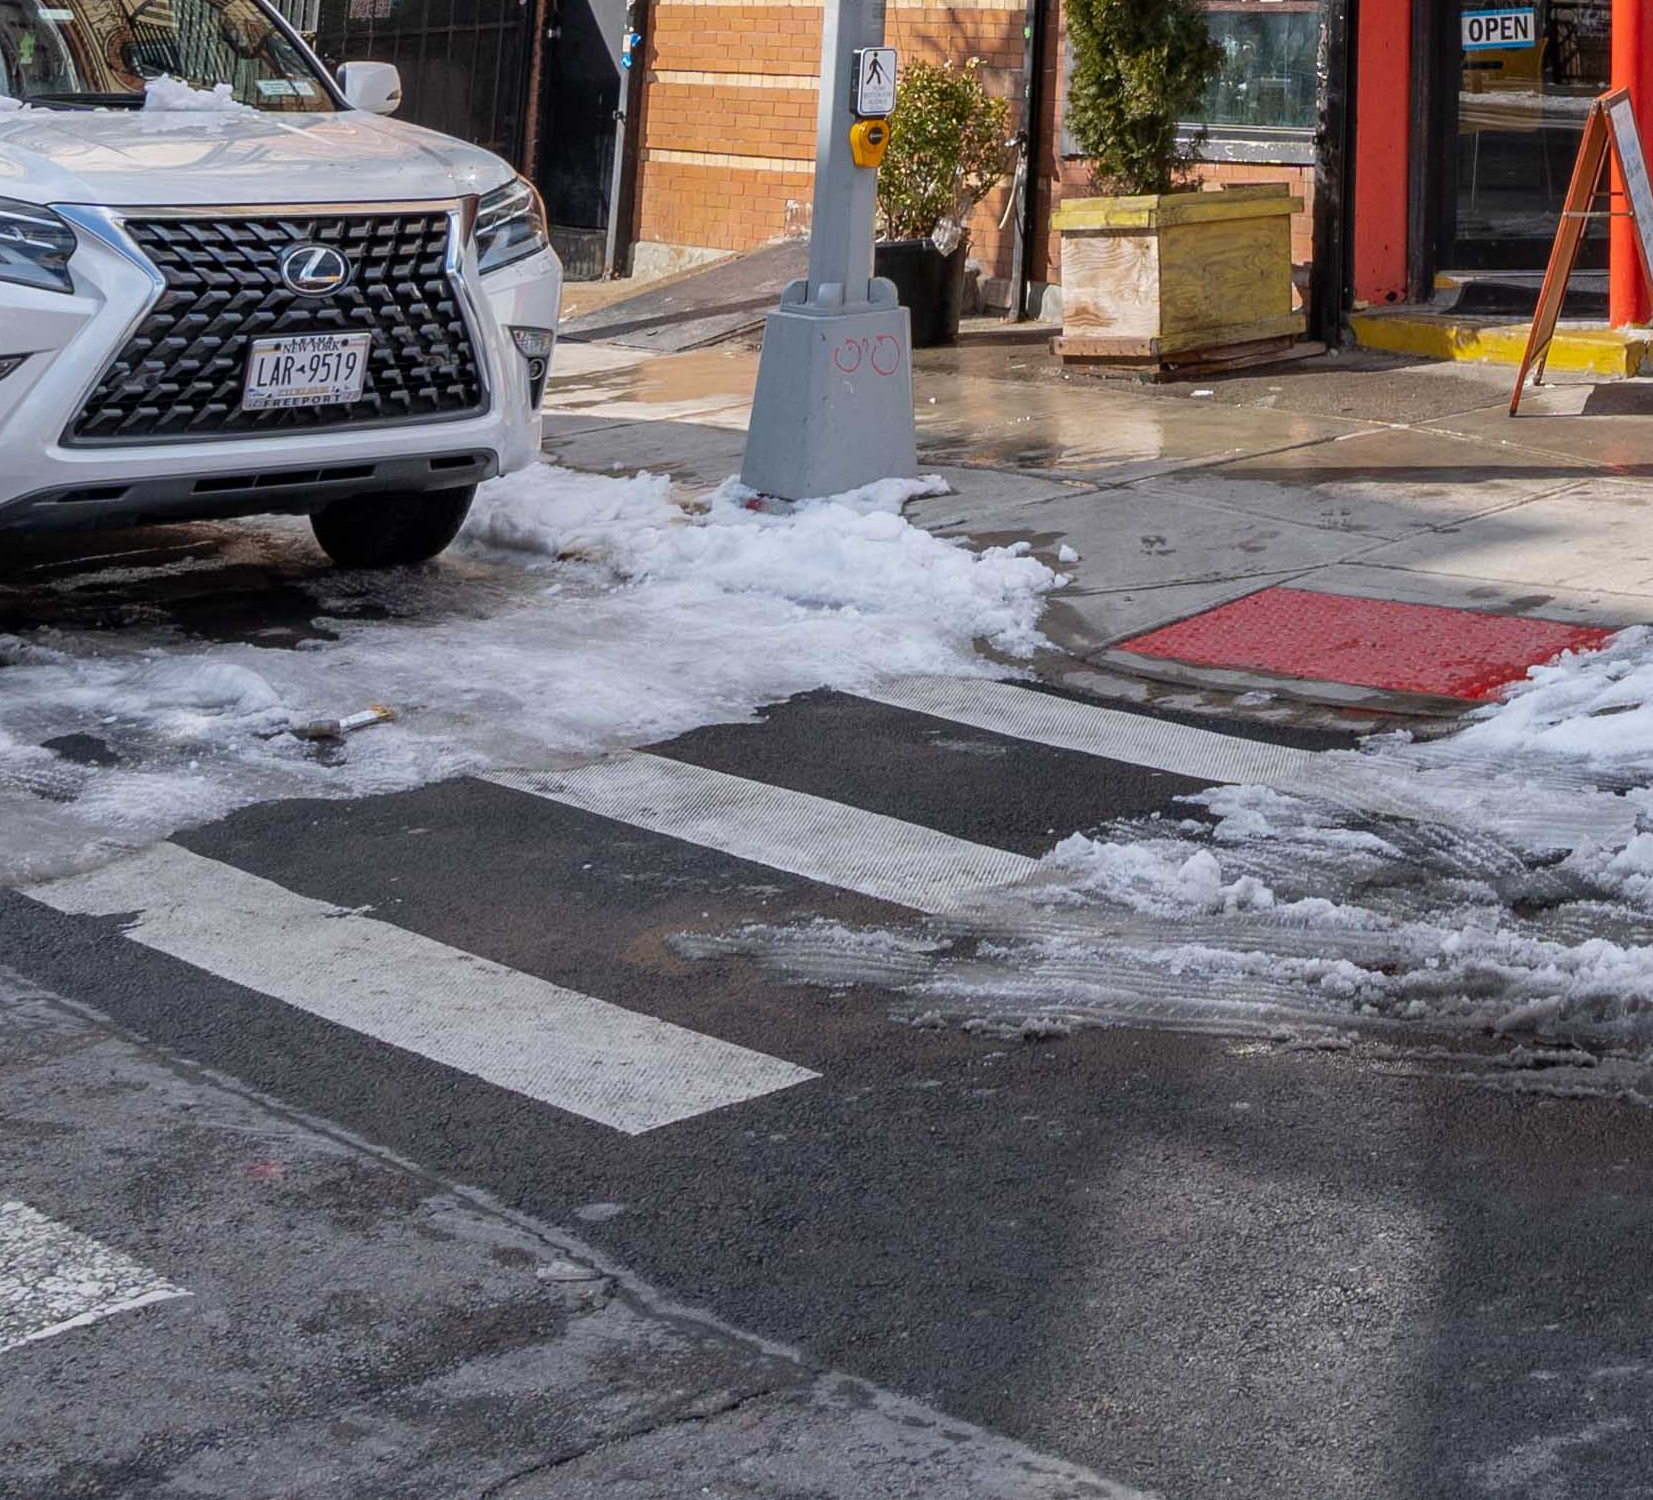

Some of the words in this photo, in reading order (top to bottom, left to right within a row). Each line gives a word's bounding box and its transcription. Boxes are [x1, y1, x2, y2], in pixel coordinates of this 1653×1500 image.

[1468, 15, 1528, 42] OPEN
[283, 344, 308, 354] NEW
[310, 340, 340, 352] YORK
[257, 355, 295, 387] LAR
[308, 352, 357, 383] 9519
[264, 393, 342, 408] FREEPORT
